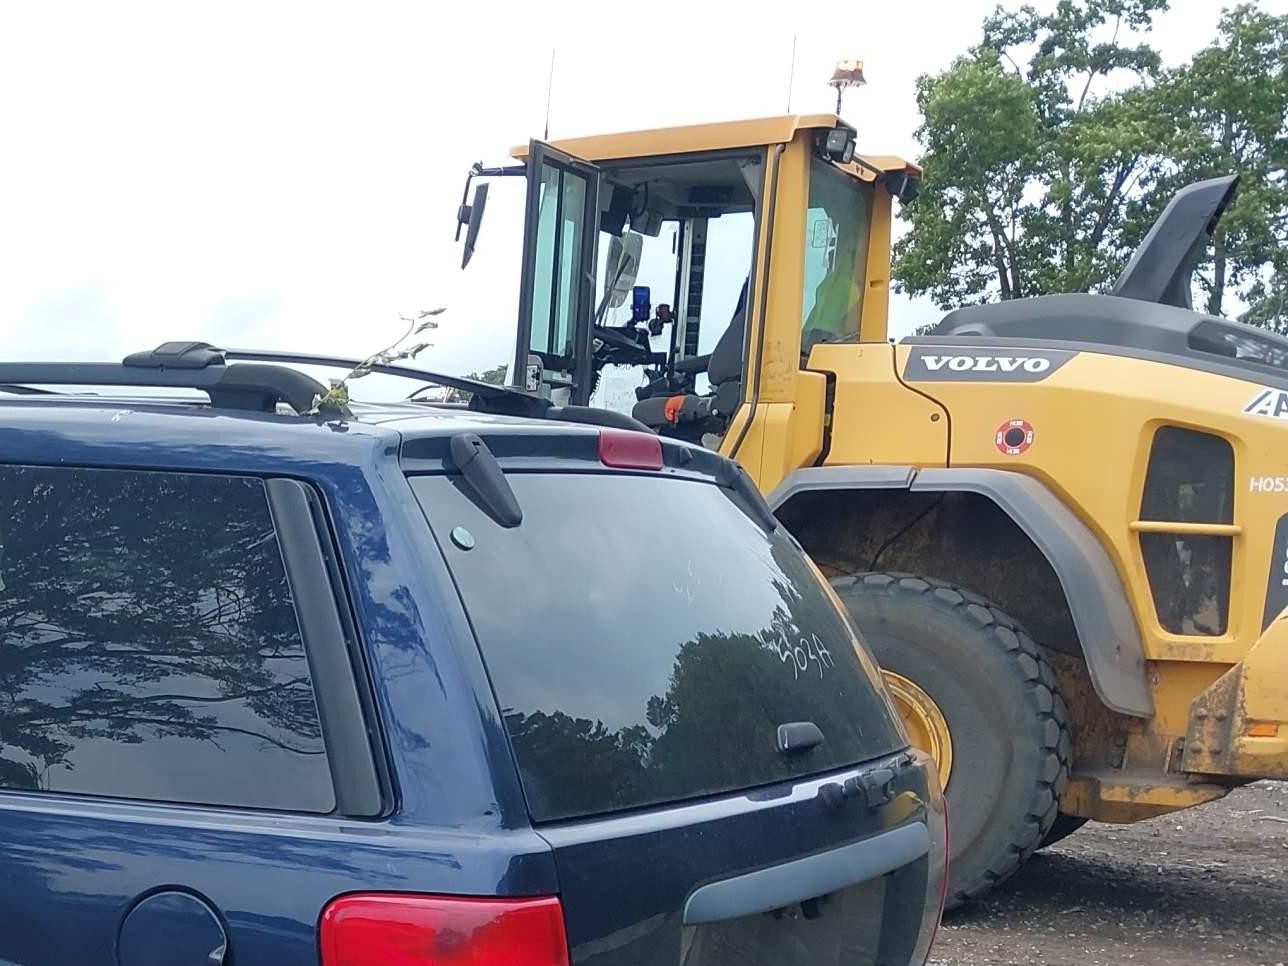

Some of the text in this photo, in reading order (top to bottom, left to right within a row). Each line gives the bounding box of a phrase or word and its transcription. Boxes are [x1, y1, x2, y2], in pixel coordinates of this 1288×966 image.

[920, 355, 1050, 373] VOLVO
[1249, 476, 1288, 492] H05
[776, 631, 836, 681] 503A
